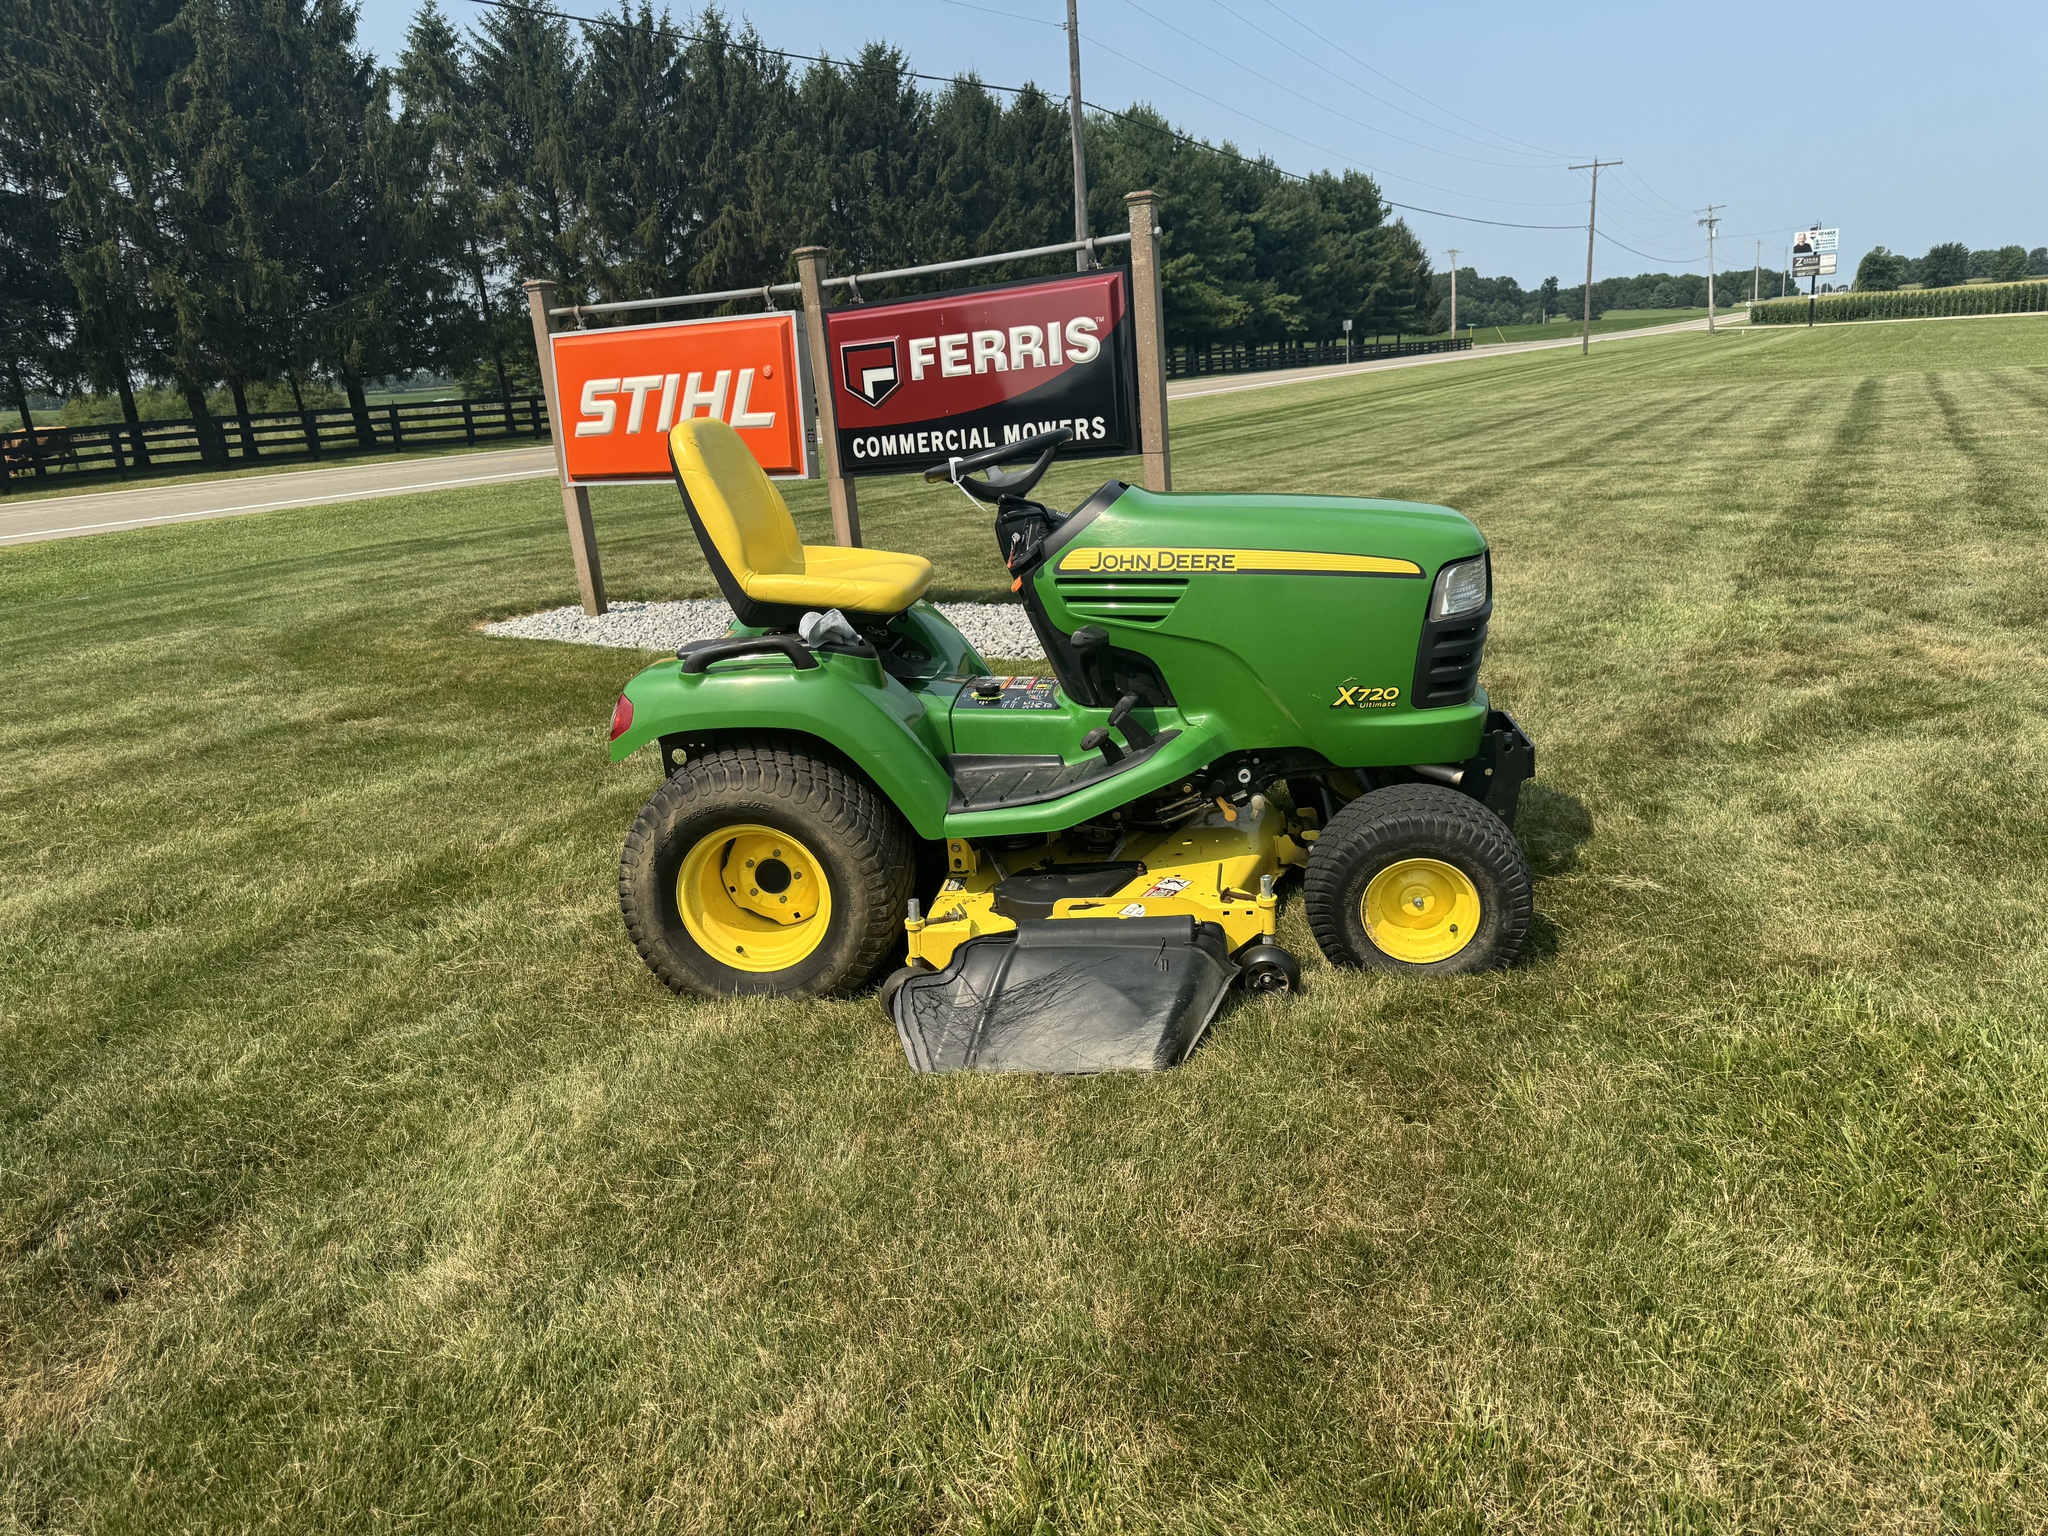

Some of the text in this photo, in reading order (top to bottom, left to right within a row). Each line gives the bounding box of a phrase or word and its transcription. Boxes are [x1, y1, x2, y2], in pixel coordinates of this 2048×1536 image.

[908, 316, 1101, 381] FERRIS
[574, 368, 776, 438] STIHL
[852, 427, 996, 459] COMMERCIAL
[1089, 551, 1236, 570] JOHN DEERE
[1332, 686, 1400, 706] X720
